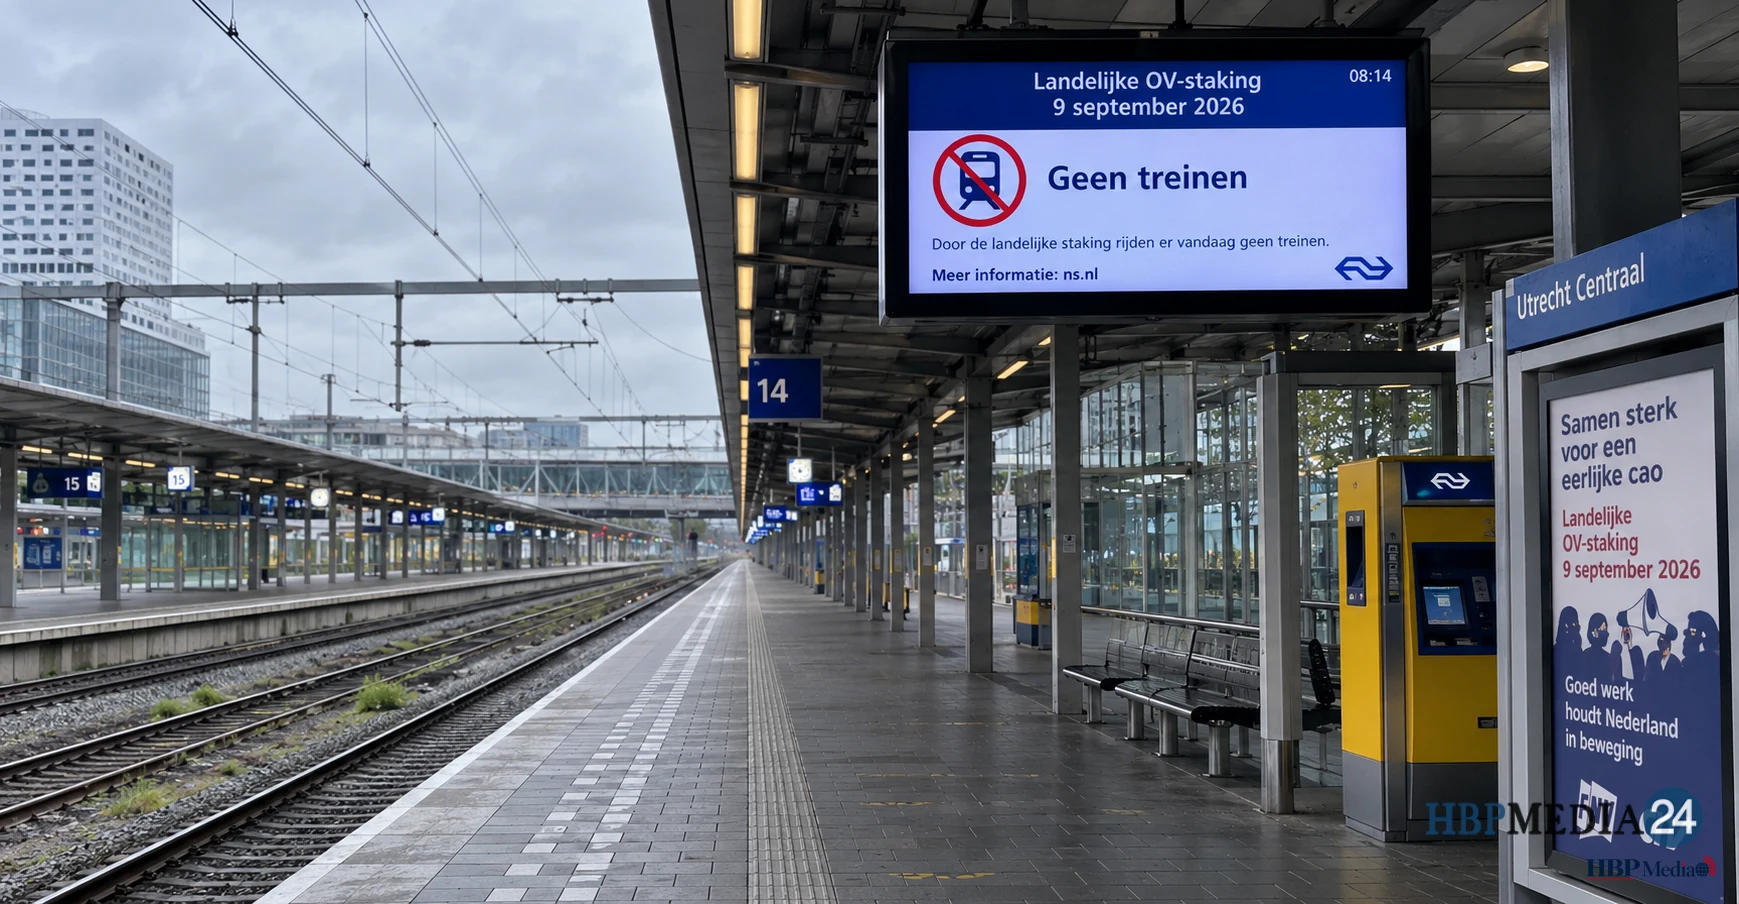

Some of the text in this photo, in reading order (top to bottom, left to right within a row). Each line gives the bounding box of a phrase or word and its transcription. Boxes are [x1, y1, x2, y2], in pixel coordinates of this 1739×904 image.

[1034, 70, 1261, 95] Landelijke OV-staking
[1349, 69, 1392, 83] 08:14
[1053, 96, 1245, 121] 9 september 2026
[1048, 163, 1247, 191] Geen treinen
[932, 234, 1329, 253] Door de landelijke staking rijden er vandaag geen treinen.
[932, 267, 1098, 282] Meer informatie: ns.nl
[1517, 251, 1645, 320] Utrecht Centraal
[757, 378, 789, 403] 14
[1561, 395, 1678, 436] Samen sterk
[1561, 437, 1636, 463] voor een
[64, 476, 80, 491] 15
[173, 474, 185, 487] 15
[1561, 463, 1663, 494] eerlijke cao
[1562, 505, 1633, 529] Landelijke
[1563, 532, 1639, 557] OV-staking
[1562, 559, 1701, 582] 9 september 2026
[1565, 675, 1634, 702] Goed werk
[1565, 701, 1679, 740] houdt Nederland
[1565, 728, 1644, 767] in beweging
